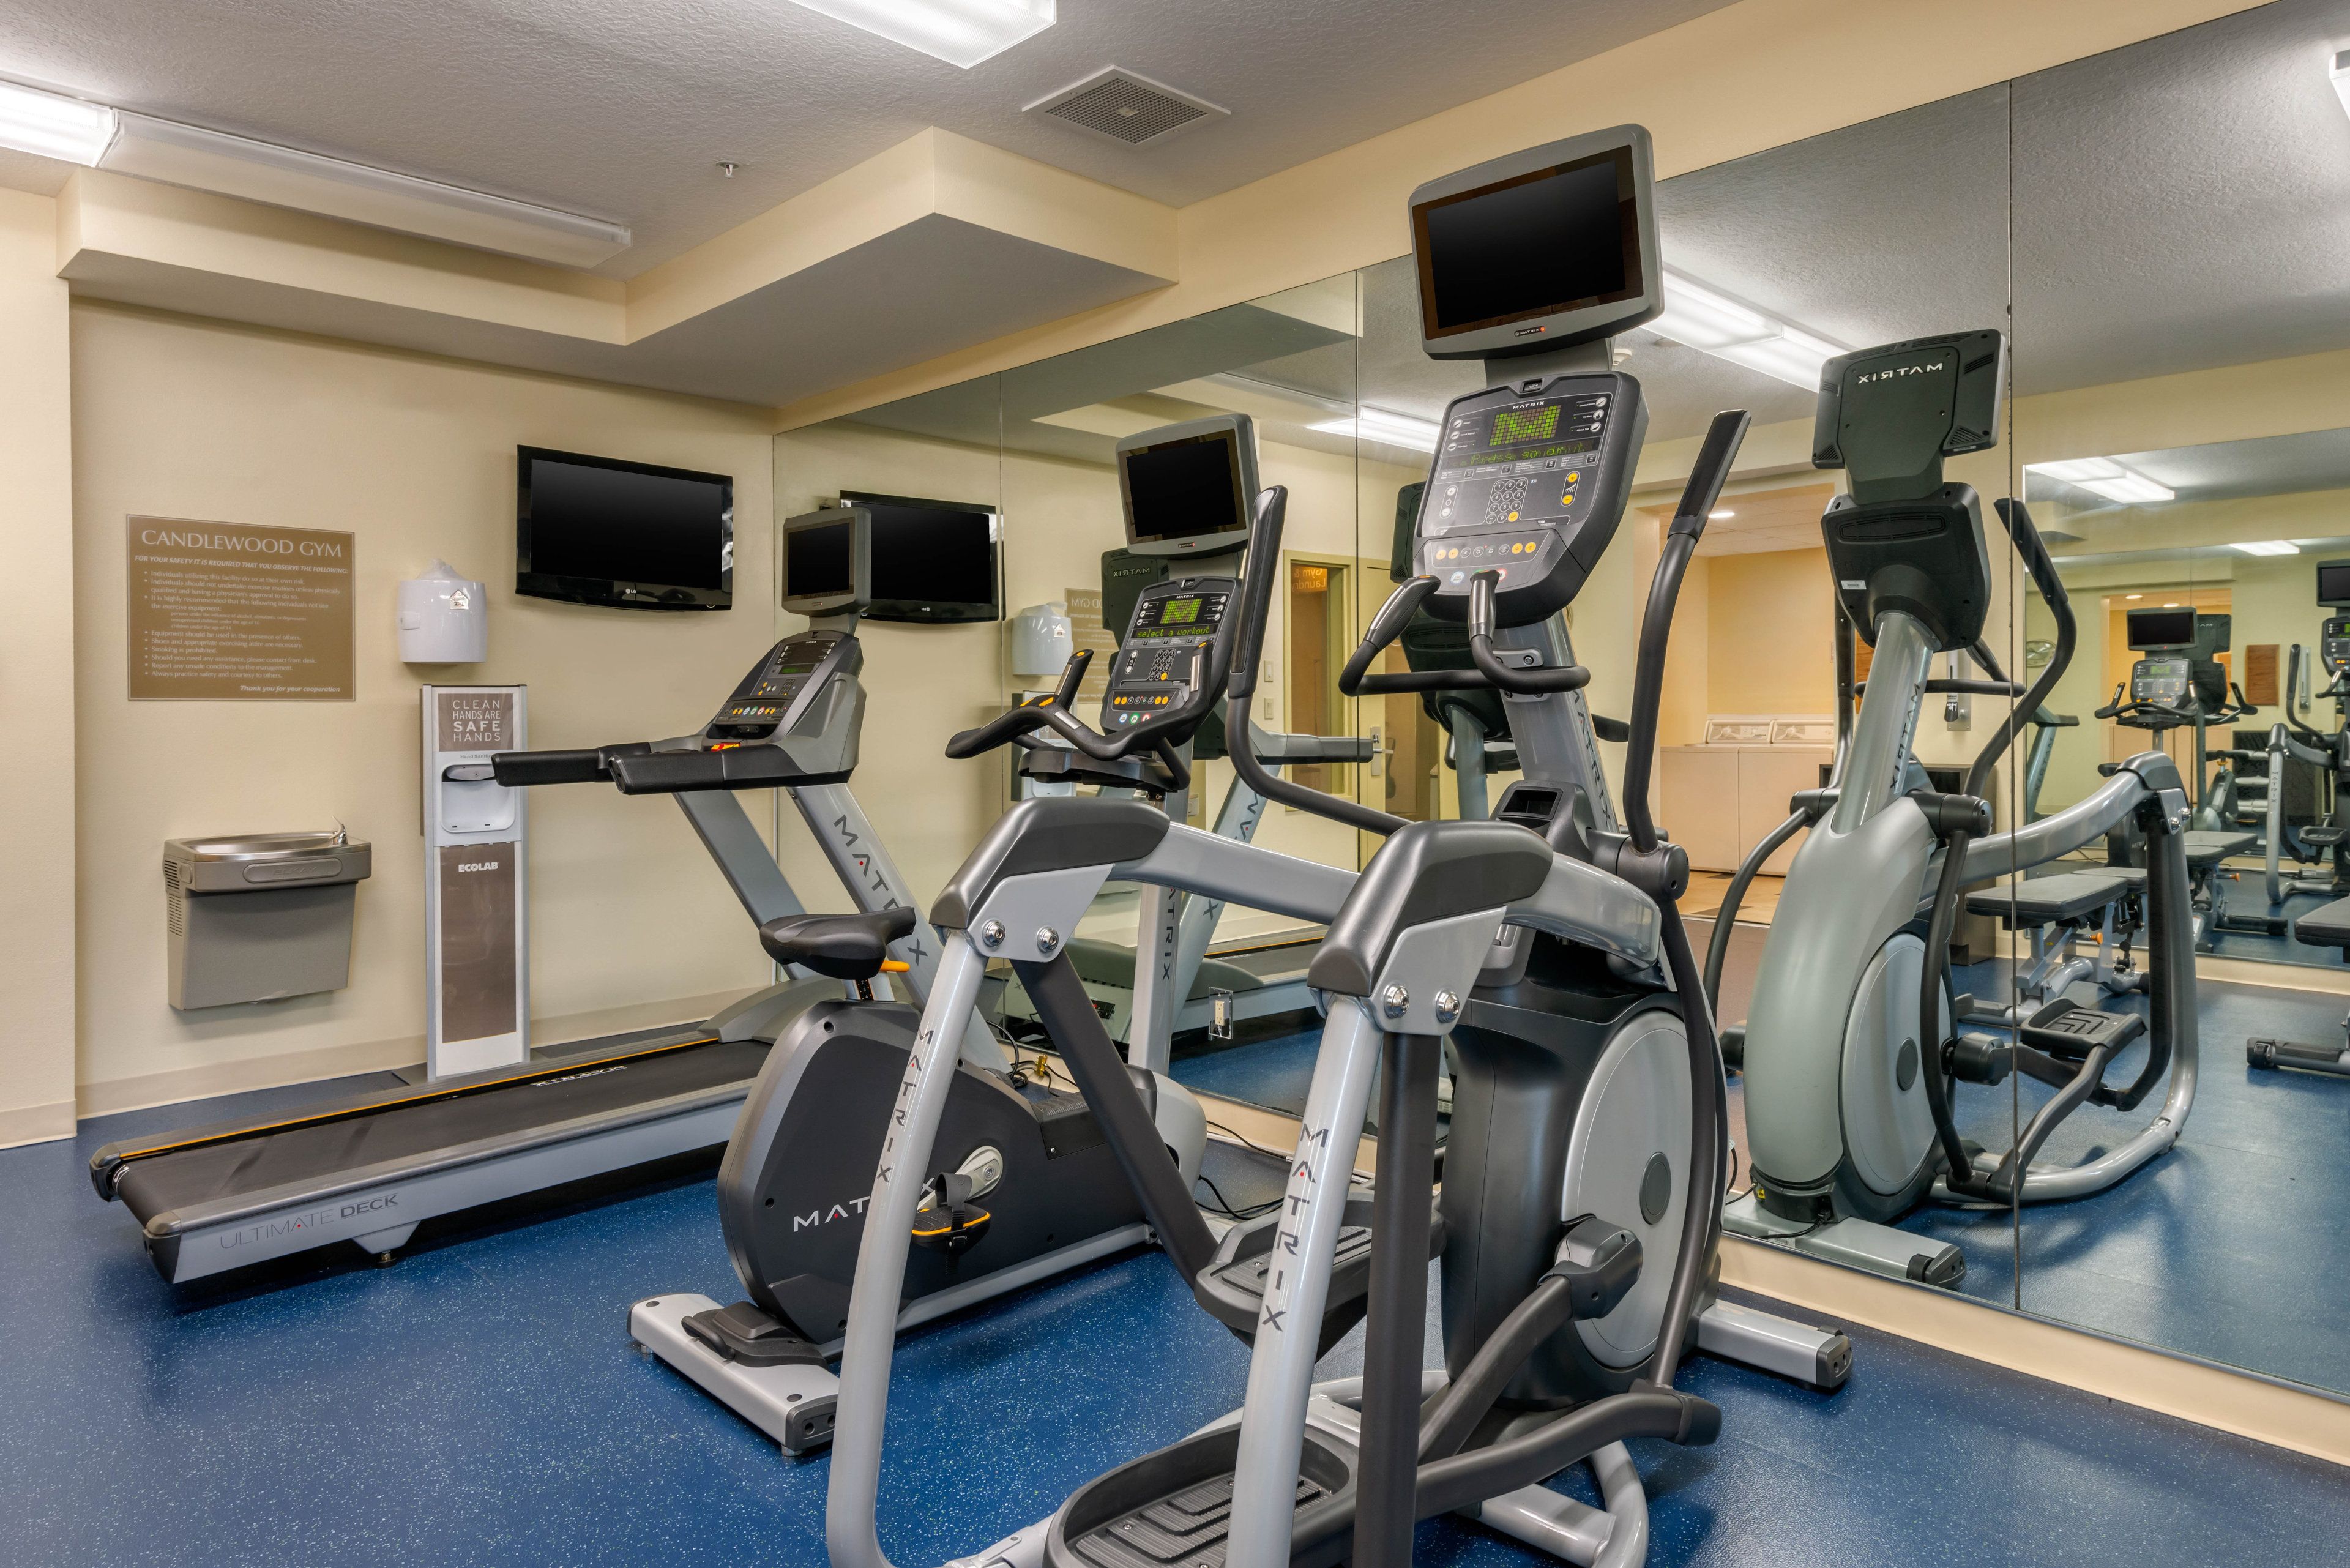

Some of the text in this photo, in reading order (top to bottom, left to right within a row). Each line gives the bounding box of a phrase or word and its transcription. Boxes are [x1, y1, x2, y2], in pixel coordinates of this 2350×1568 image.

[1513, 401, 1545, 409] MATRIX
[141, 529, 341, 557] CANDLEWOOD GYM
[1137, 629, 1164, 638] select
[1177, 625, 1210, 636] workout
[453, 700, 500, 709] CLEAN
[453, 710, 501, 720] HANDS ARE
[453, 721, 501, 732] SAFE
[453, 732, 501, 742] HANDS
[273, 866, 318, 876] ELKAY
[458, 861, 499, 873] ECOLAB
[834, 814, 928, 966] MATX
[876, 1029, 934, 1183] MATRIX
[793, 1176, 936, 1232] MATX
[220, 1194, 398, 1249] ULTIMATE DECK
[1262, 1123, 1329, 1332] MATRIX
